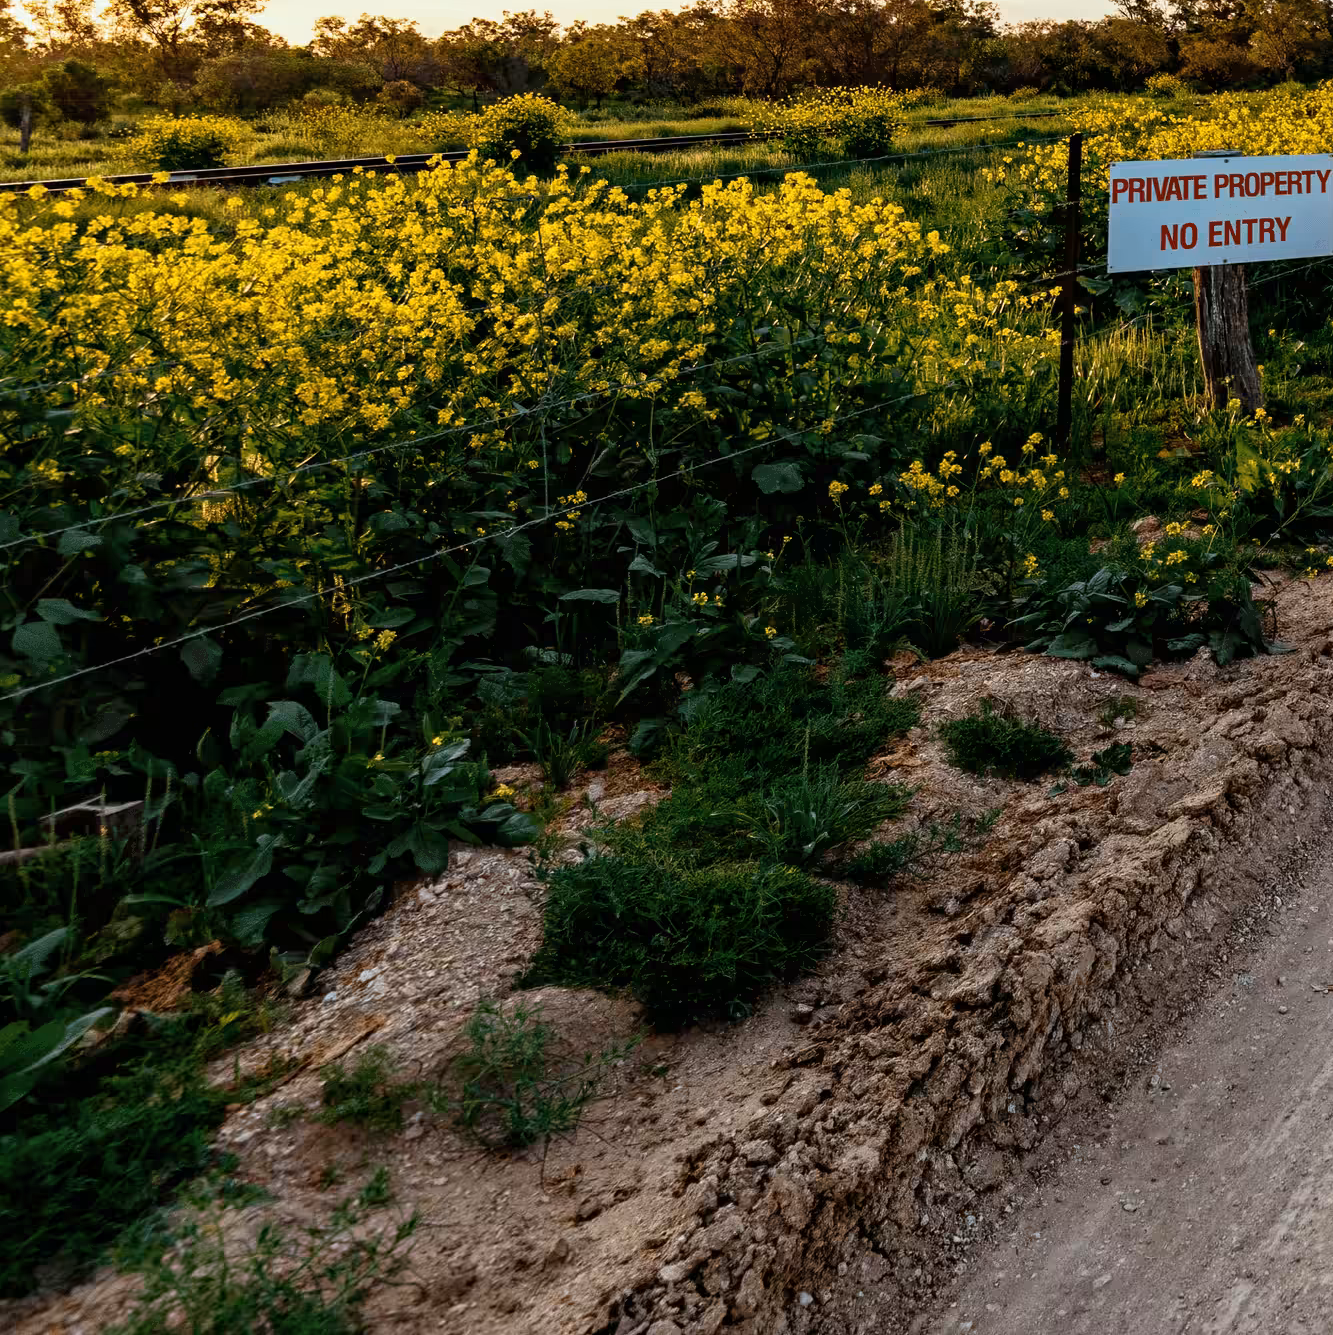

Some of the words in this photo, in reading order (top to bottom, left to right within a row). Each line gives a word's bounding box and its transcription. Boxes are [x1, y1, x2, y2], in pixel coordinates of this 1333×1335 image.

[1112, 175, 1208, 204] PRIVATE
[1214, 169, 1332, 199] PROPERTY
[1160, 222, 1198, 251] NO
[1208, 216, 1292, 247] ENTRY
